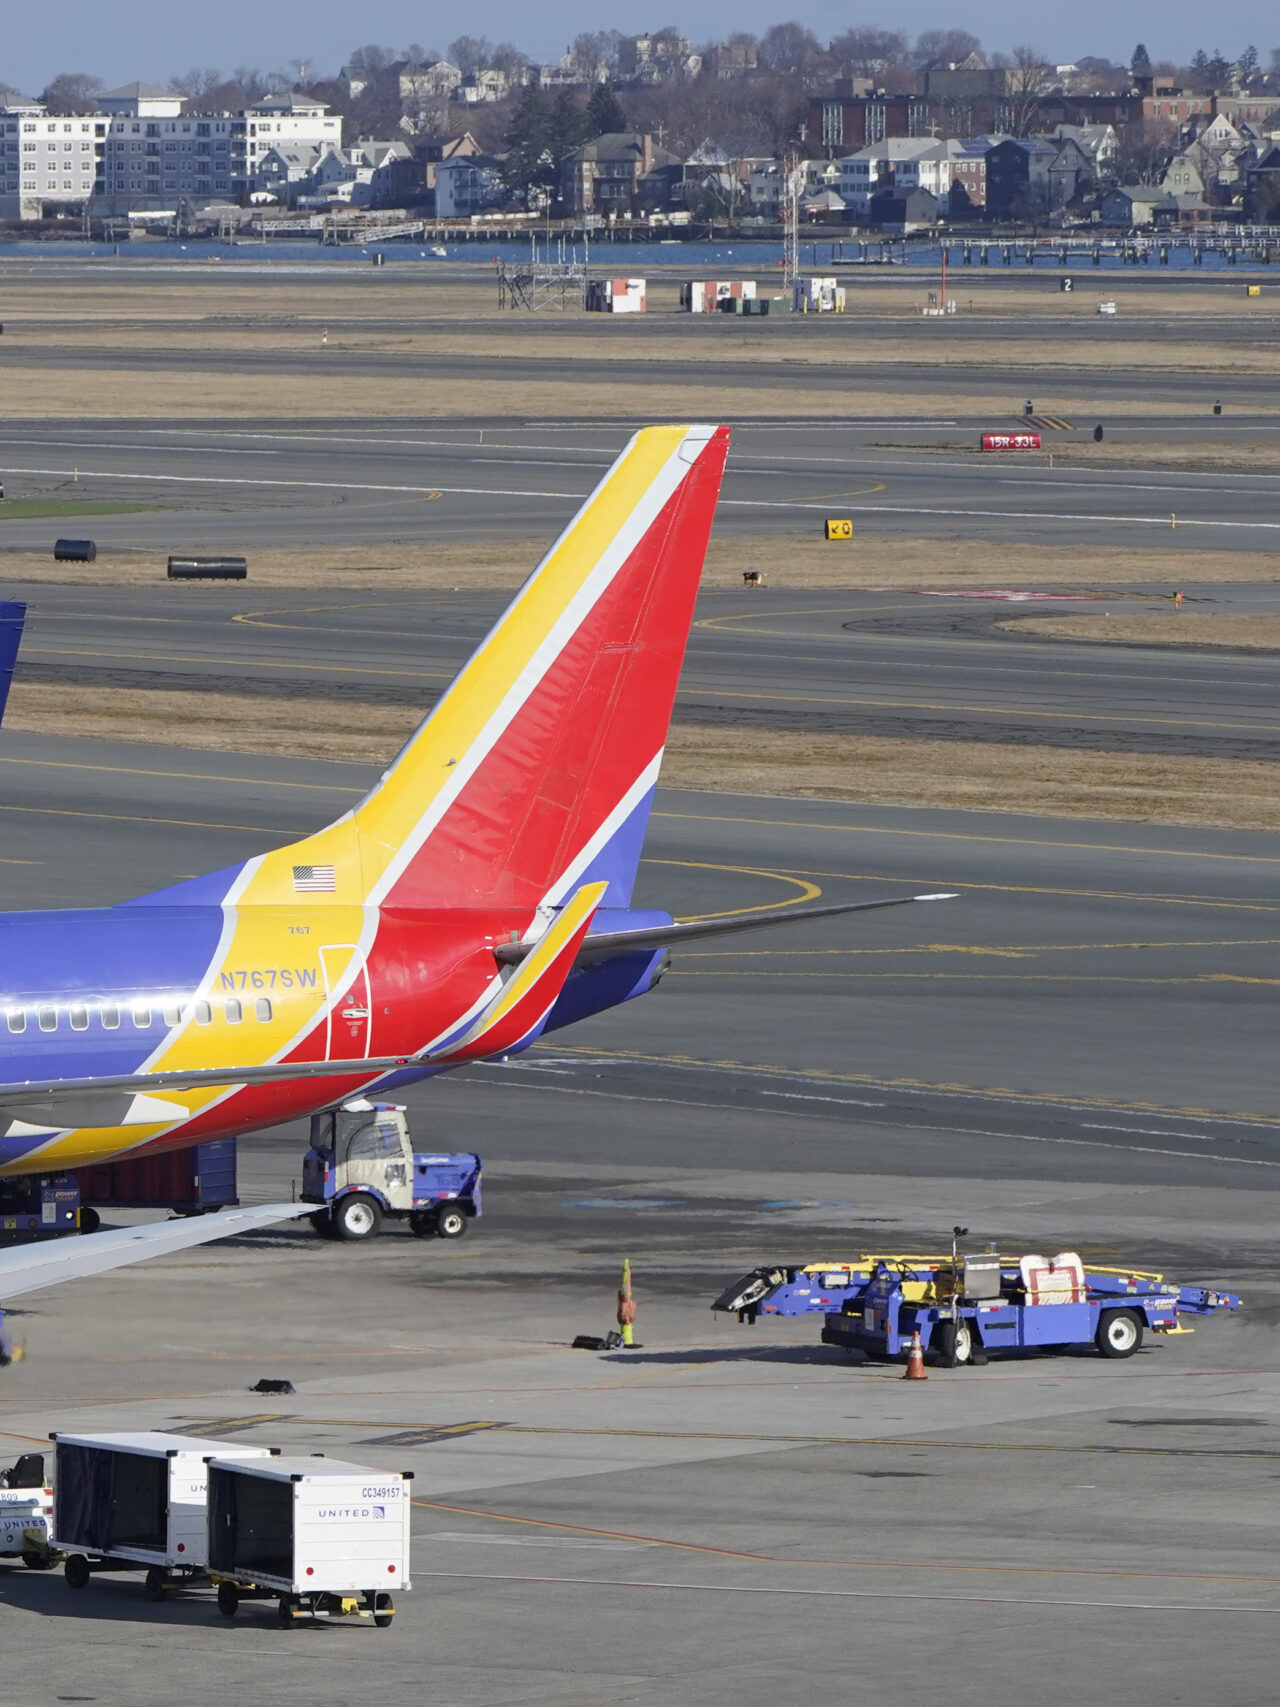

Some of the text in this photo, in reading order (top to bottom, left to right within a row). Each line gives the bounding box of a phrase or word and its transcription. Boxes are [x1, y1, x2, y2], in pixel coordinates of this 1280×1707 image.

[1064, 278, 1072, 291] 2
[989, 435, 1037, 447] 15R-33L
[288, 926, 310, 935] 767
[220, 968, 317, 991] N767SW
[362, 1487, 400, 1498] CC349157
[318, 1509, 369, 1517] UNITED
[4, 1520, 46, 1529] UNITED
